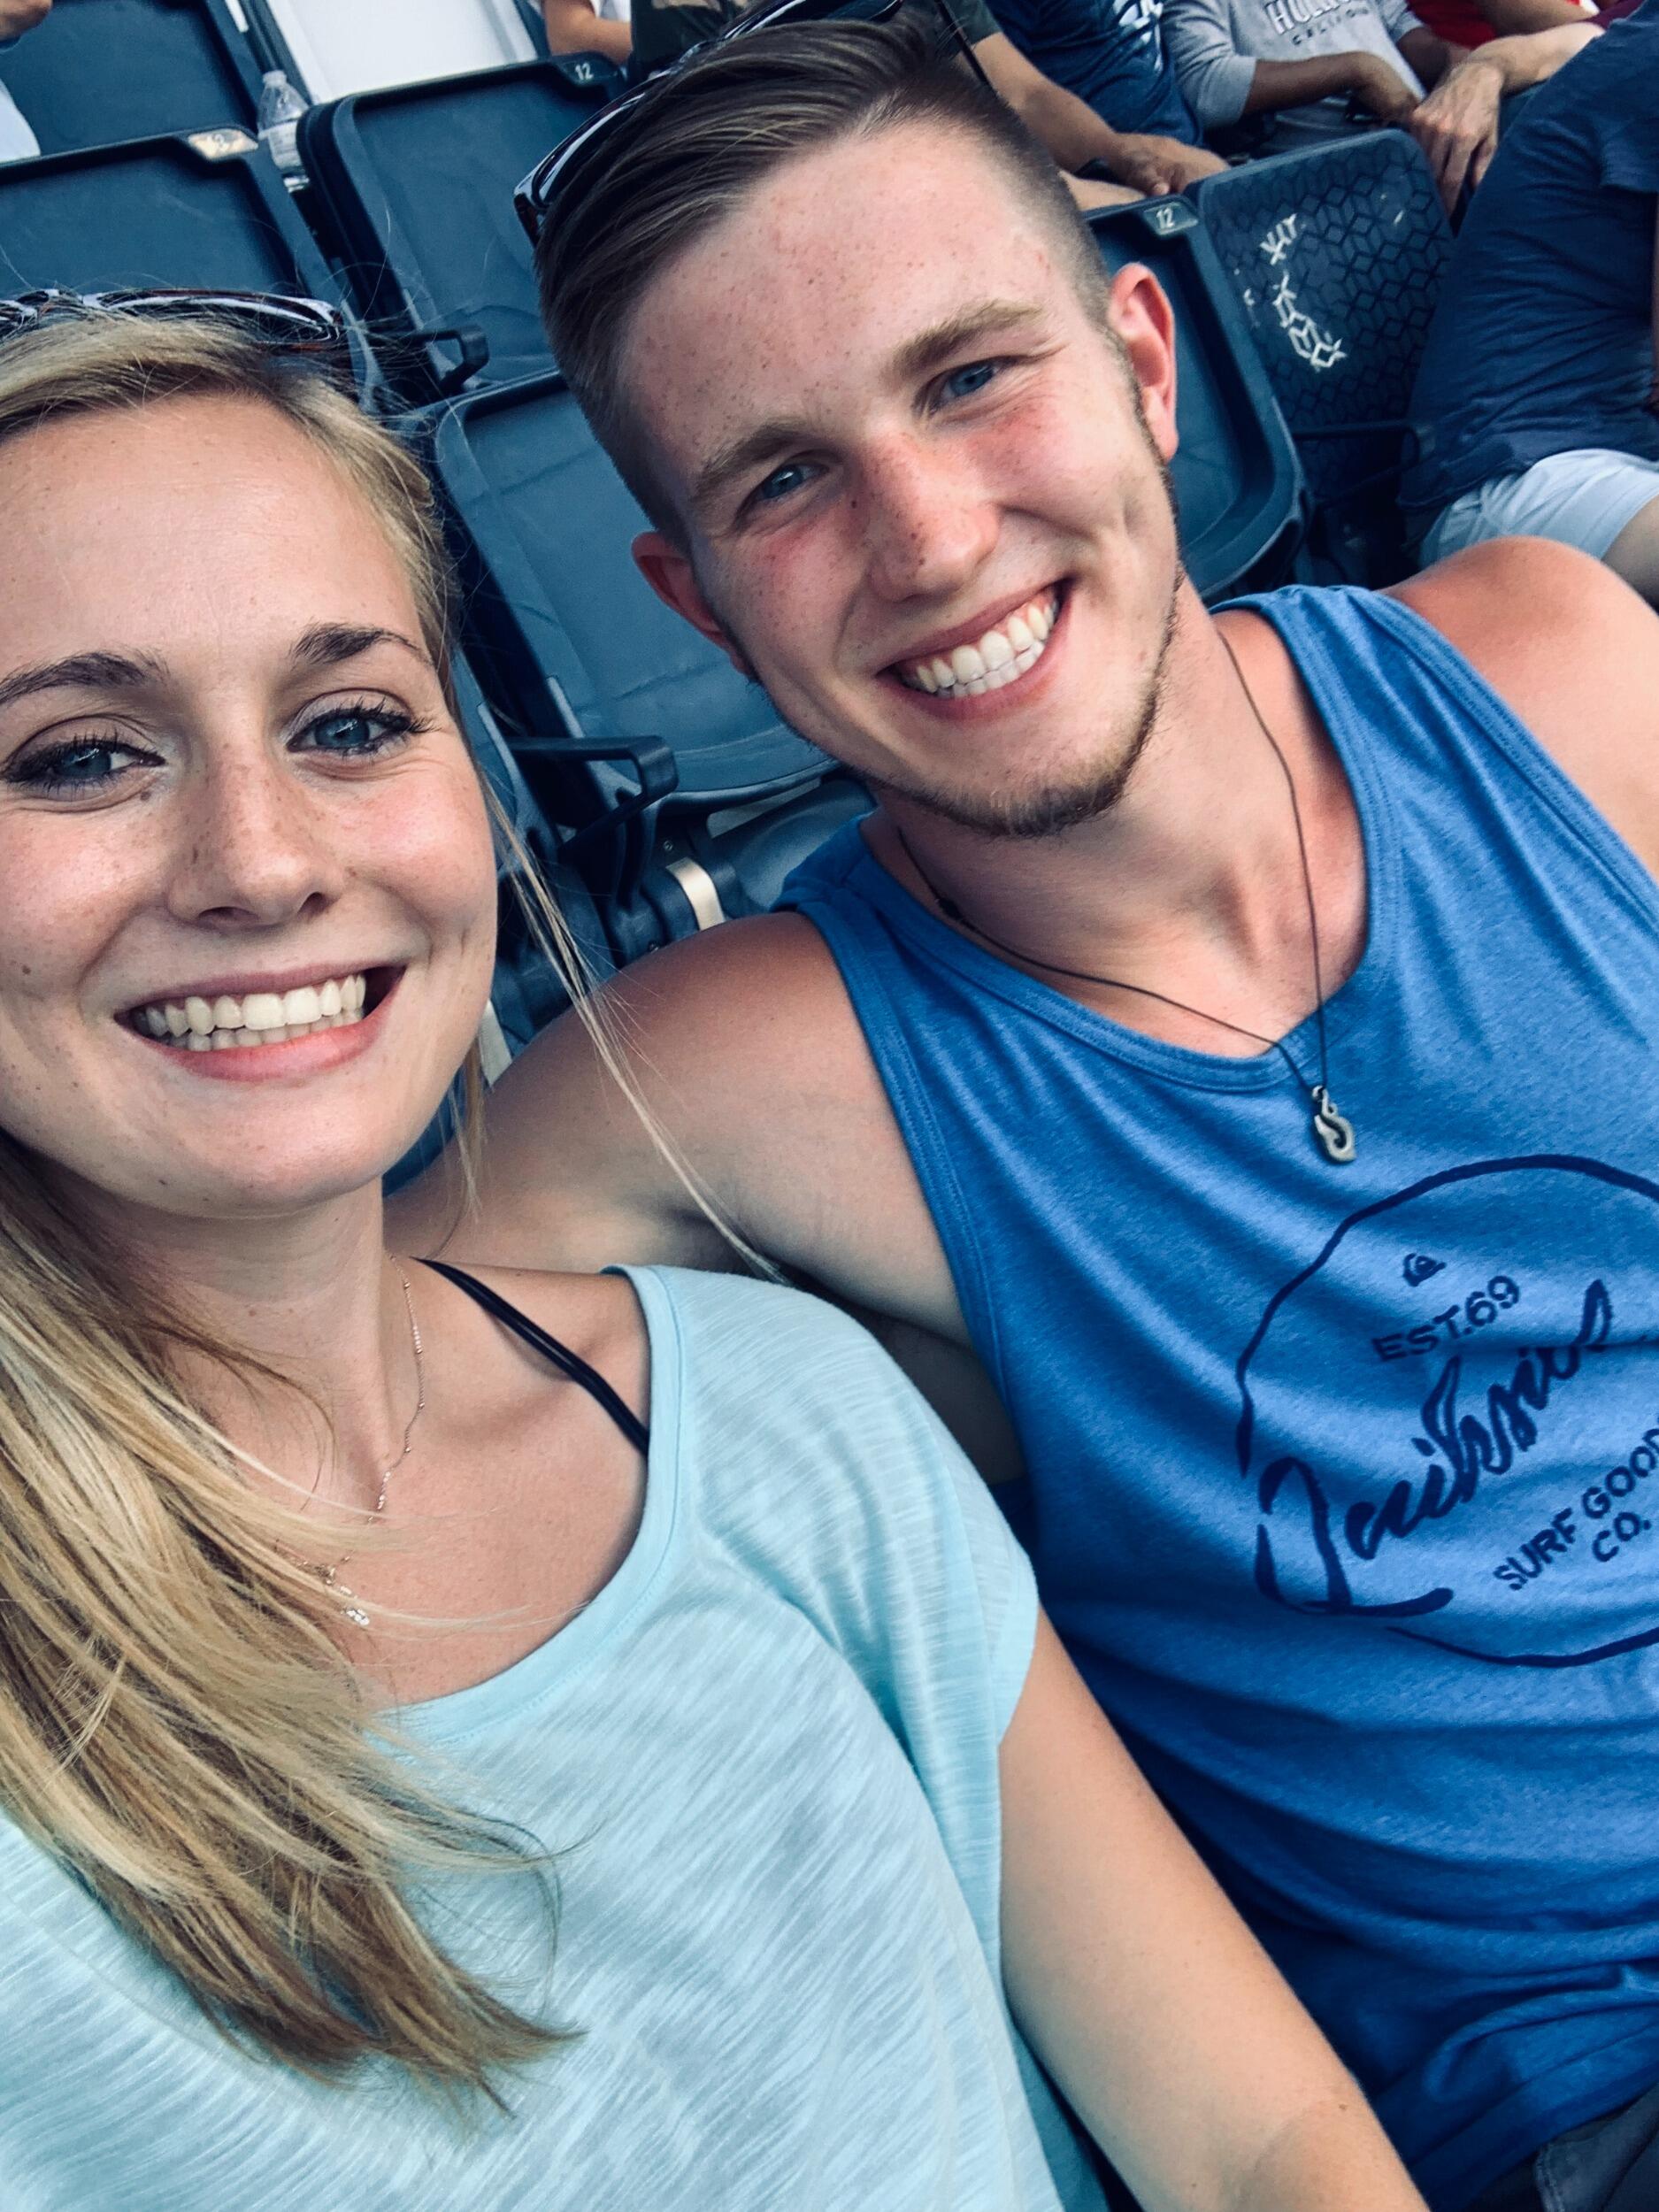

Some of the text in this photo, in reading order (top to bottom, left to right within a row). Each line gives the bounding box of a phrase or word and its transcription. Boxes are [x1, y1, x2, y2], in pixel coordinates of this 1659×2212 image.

[575, 63, 594, 81] 12
[1156, 208, 1174, 229] 12
[1494, 1507, 1576, 1590] SURF
[1593, 1511, 1652, 1563] CO.
